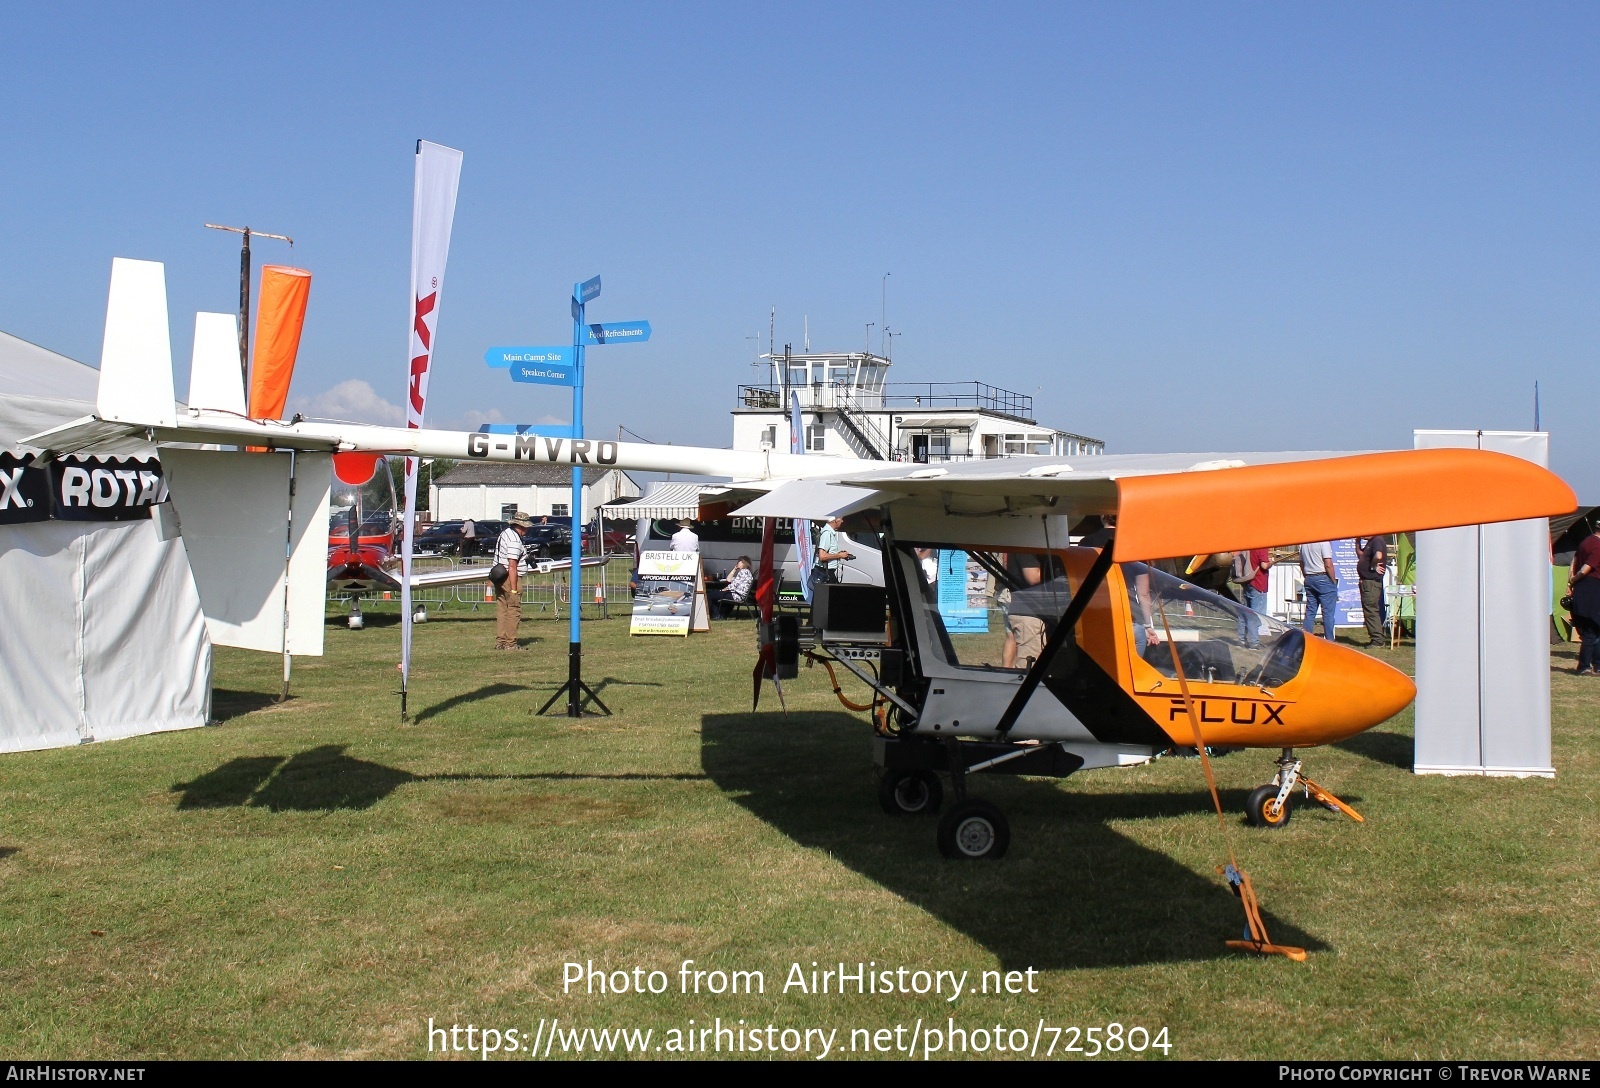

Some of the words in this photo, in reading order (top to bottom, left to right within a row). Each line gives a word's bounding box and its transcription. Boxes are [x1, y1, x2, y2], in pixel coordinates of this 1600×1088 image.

[589, 328, 643, 339] Food/Refreshments
[503, 353, 522, 361] Main
[523, 353, 546, 362] Camp
[547, 352, 562, 361] Site
[521, 367, 546, 378] Speakers
[546, 369, 566, 379] Corner
[467, 433, 618, 465] G-MVRO
[645, 552, 679, 561] BRISTELL
[681, 553, 693, 561] UK
[1169, 699, 1287, 726] FLUX
